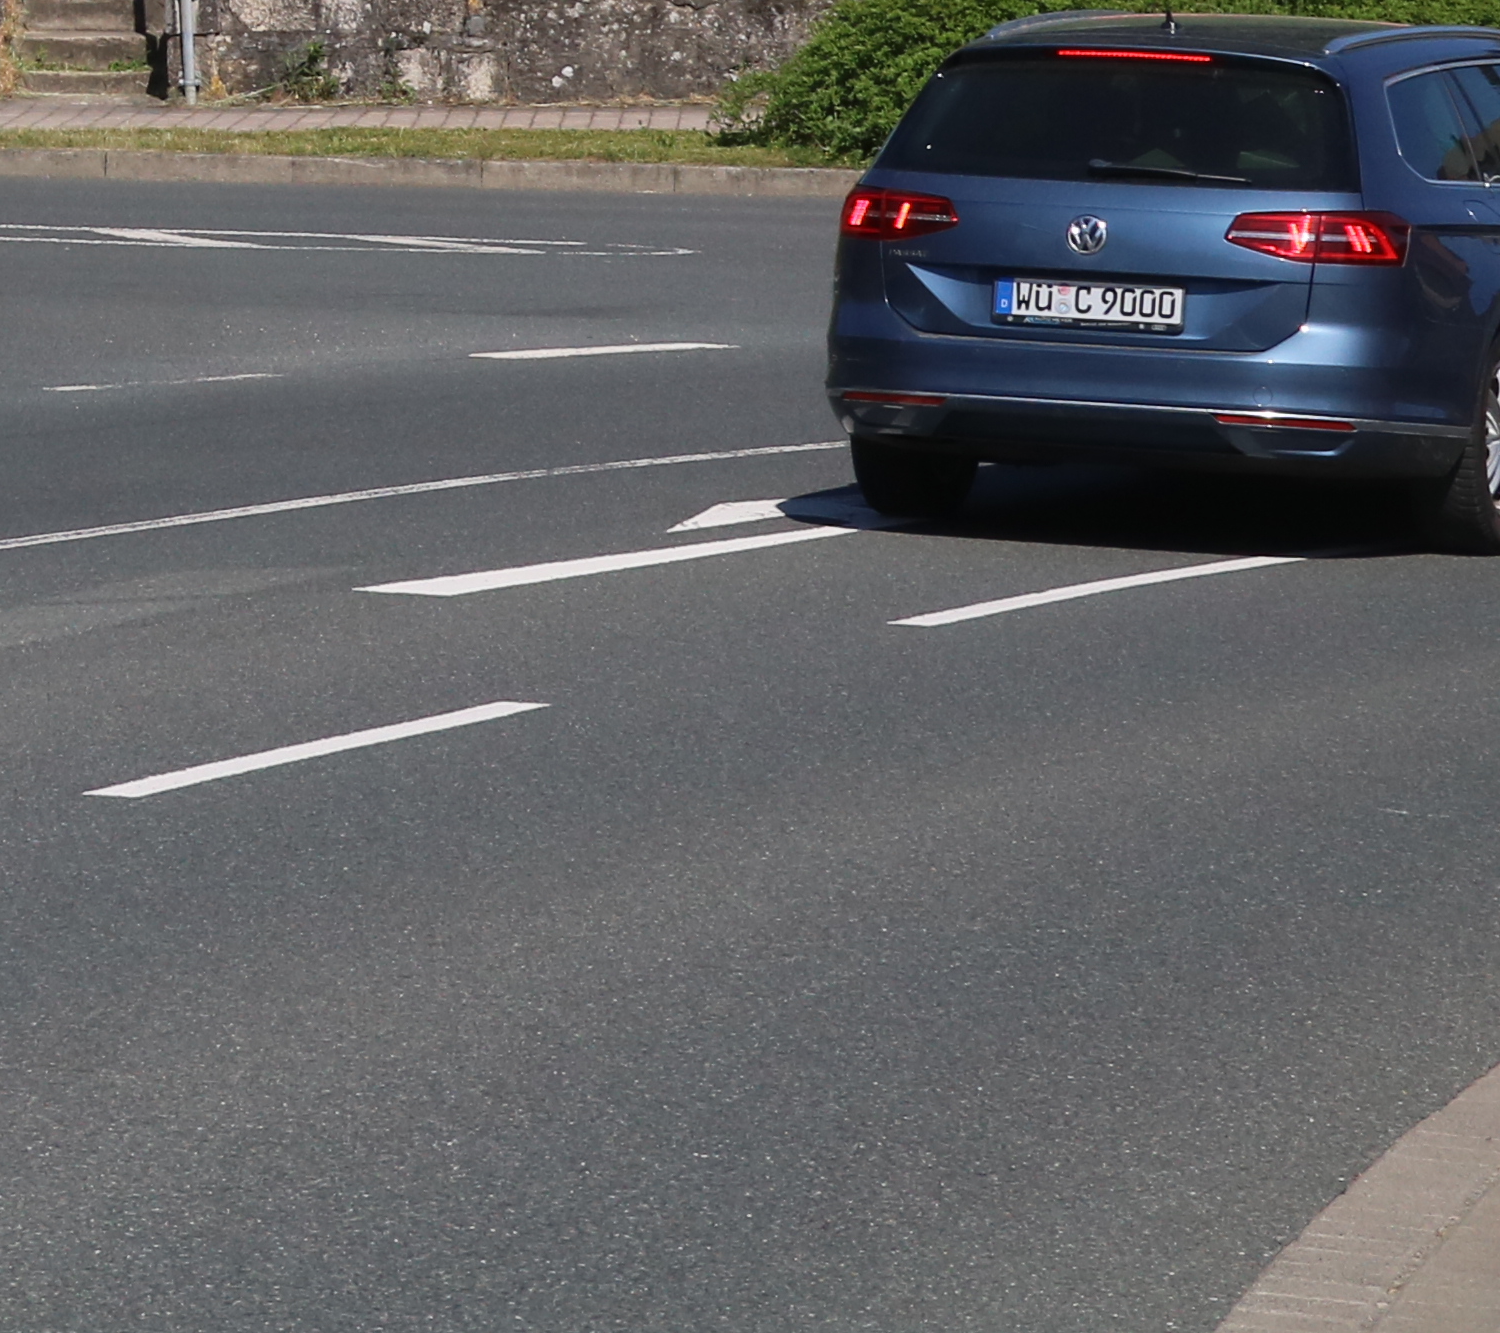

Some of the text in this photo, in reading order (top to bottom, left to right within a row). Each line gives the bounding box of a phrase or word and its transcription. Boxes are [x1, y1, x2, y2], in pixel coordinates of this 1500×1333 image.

[1000, 299, 1008, 308] D
[1075, 286, 1092, 314] C
[1101, 287, 1176, 319] 9000
